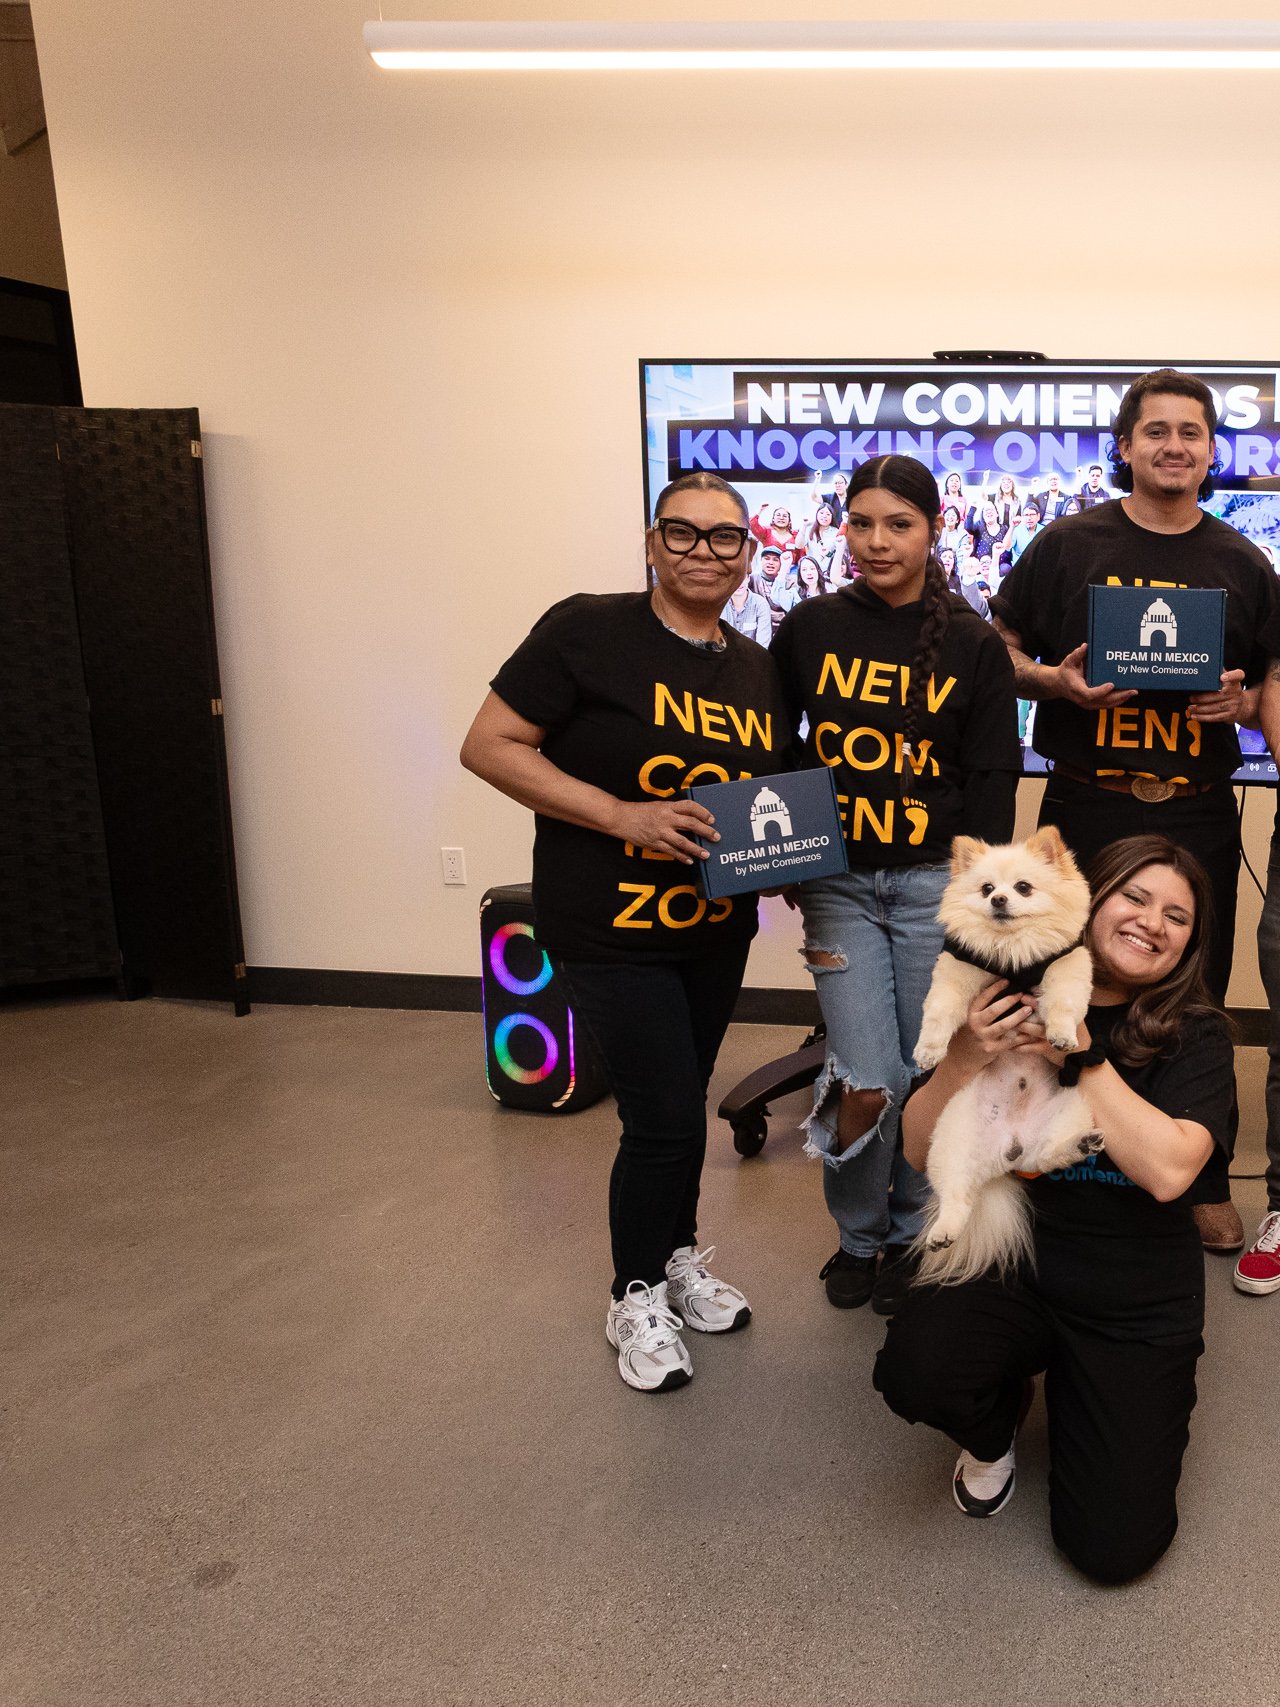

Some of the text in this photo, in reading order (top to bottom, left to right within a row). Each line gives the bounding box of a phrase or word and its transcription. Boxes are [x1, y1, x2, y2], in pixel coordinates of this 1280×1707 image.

[747, 382, 1262, 429] NEW COMIENS
[680, 429, 976, 472] KNOCKING
[992, 431, 1079, 474] ON
[1106, 650, 1210, 663] DREAM IN MEXICO
[1117, 664, 1199, 675] by New Comienzos
[654, 682, 772, 751] NEW
[815, 721, 940, 777] COM
[720, 835, 830, 865] DREAM IN MEXICO
[735, 852, 822, 877] by New Comienzos
